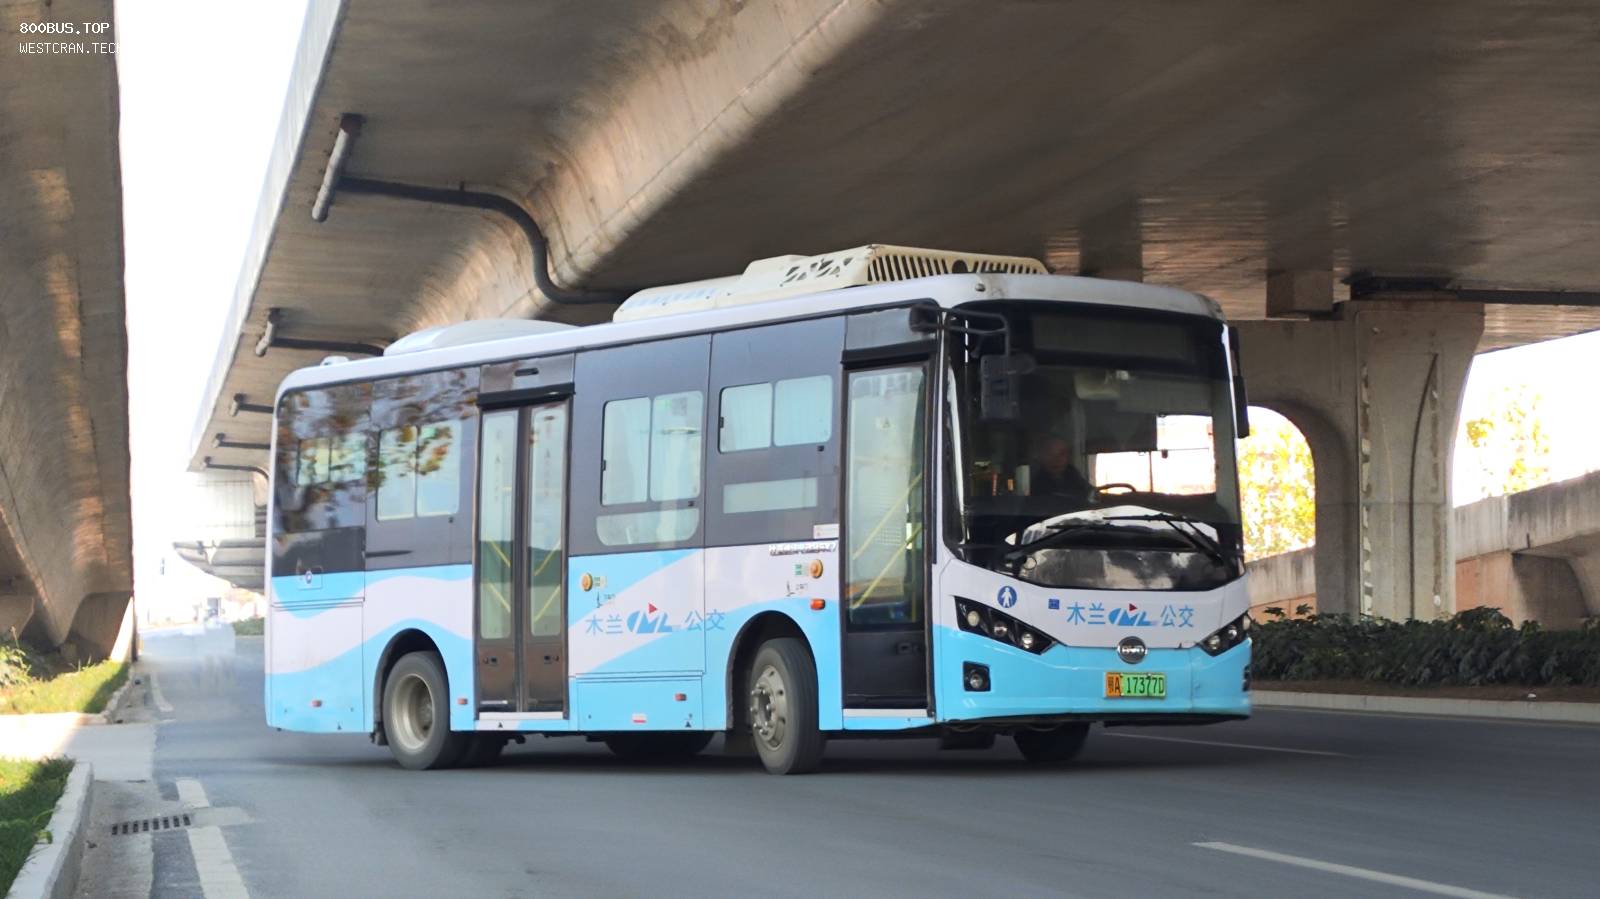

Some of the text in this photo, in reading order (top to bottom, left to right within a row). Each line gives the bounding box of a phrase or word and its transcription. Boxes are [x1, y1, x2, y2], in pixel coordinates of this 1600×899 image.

[585, 614, 624, 636] 木兰
[684, 609, 726, 632] 公交
[1067, 602, 1106, 626] 木兰
[1160, 604, 1195, 627] 公交
